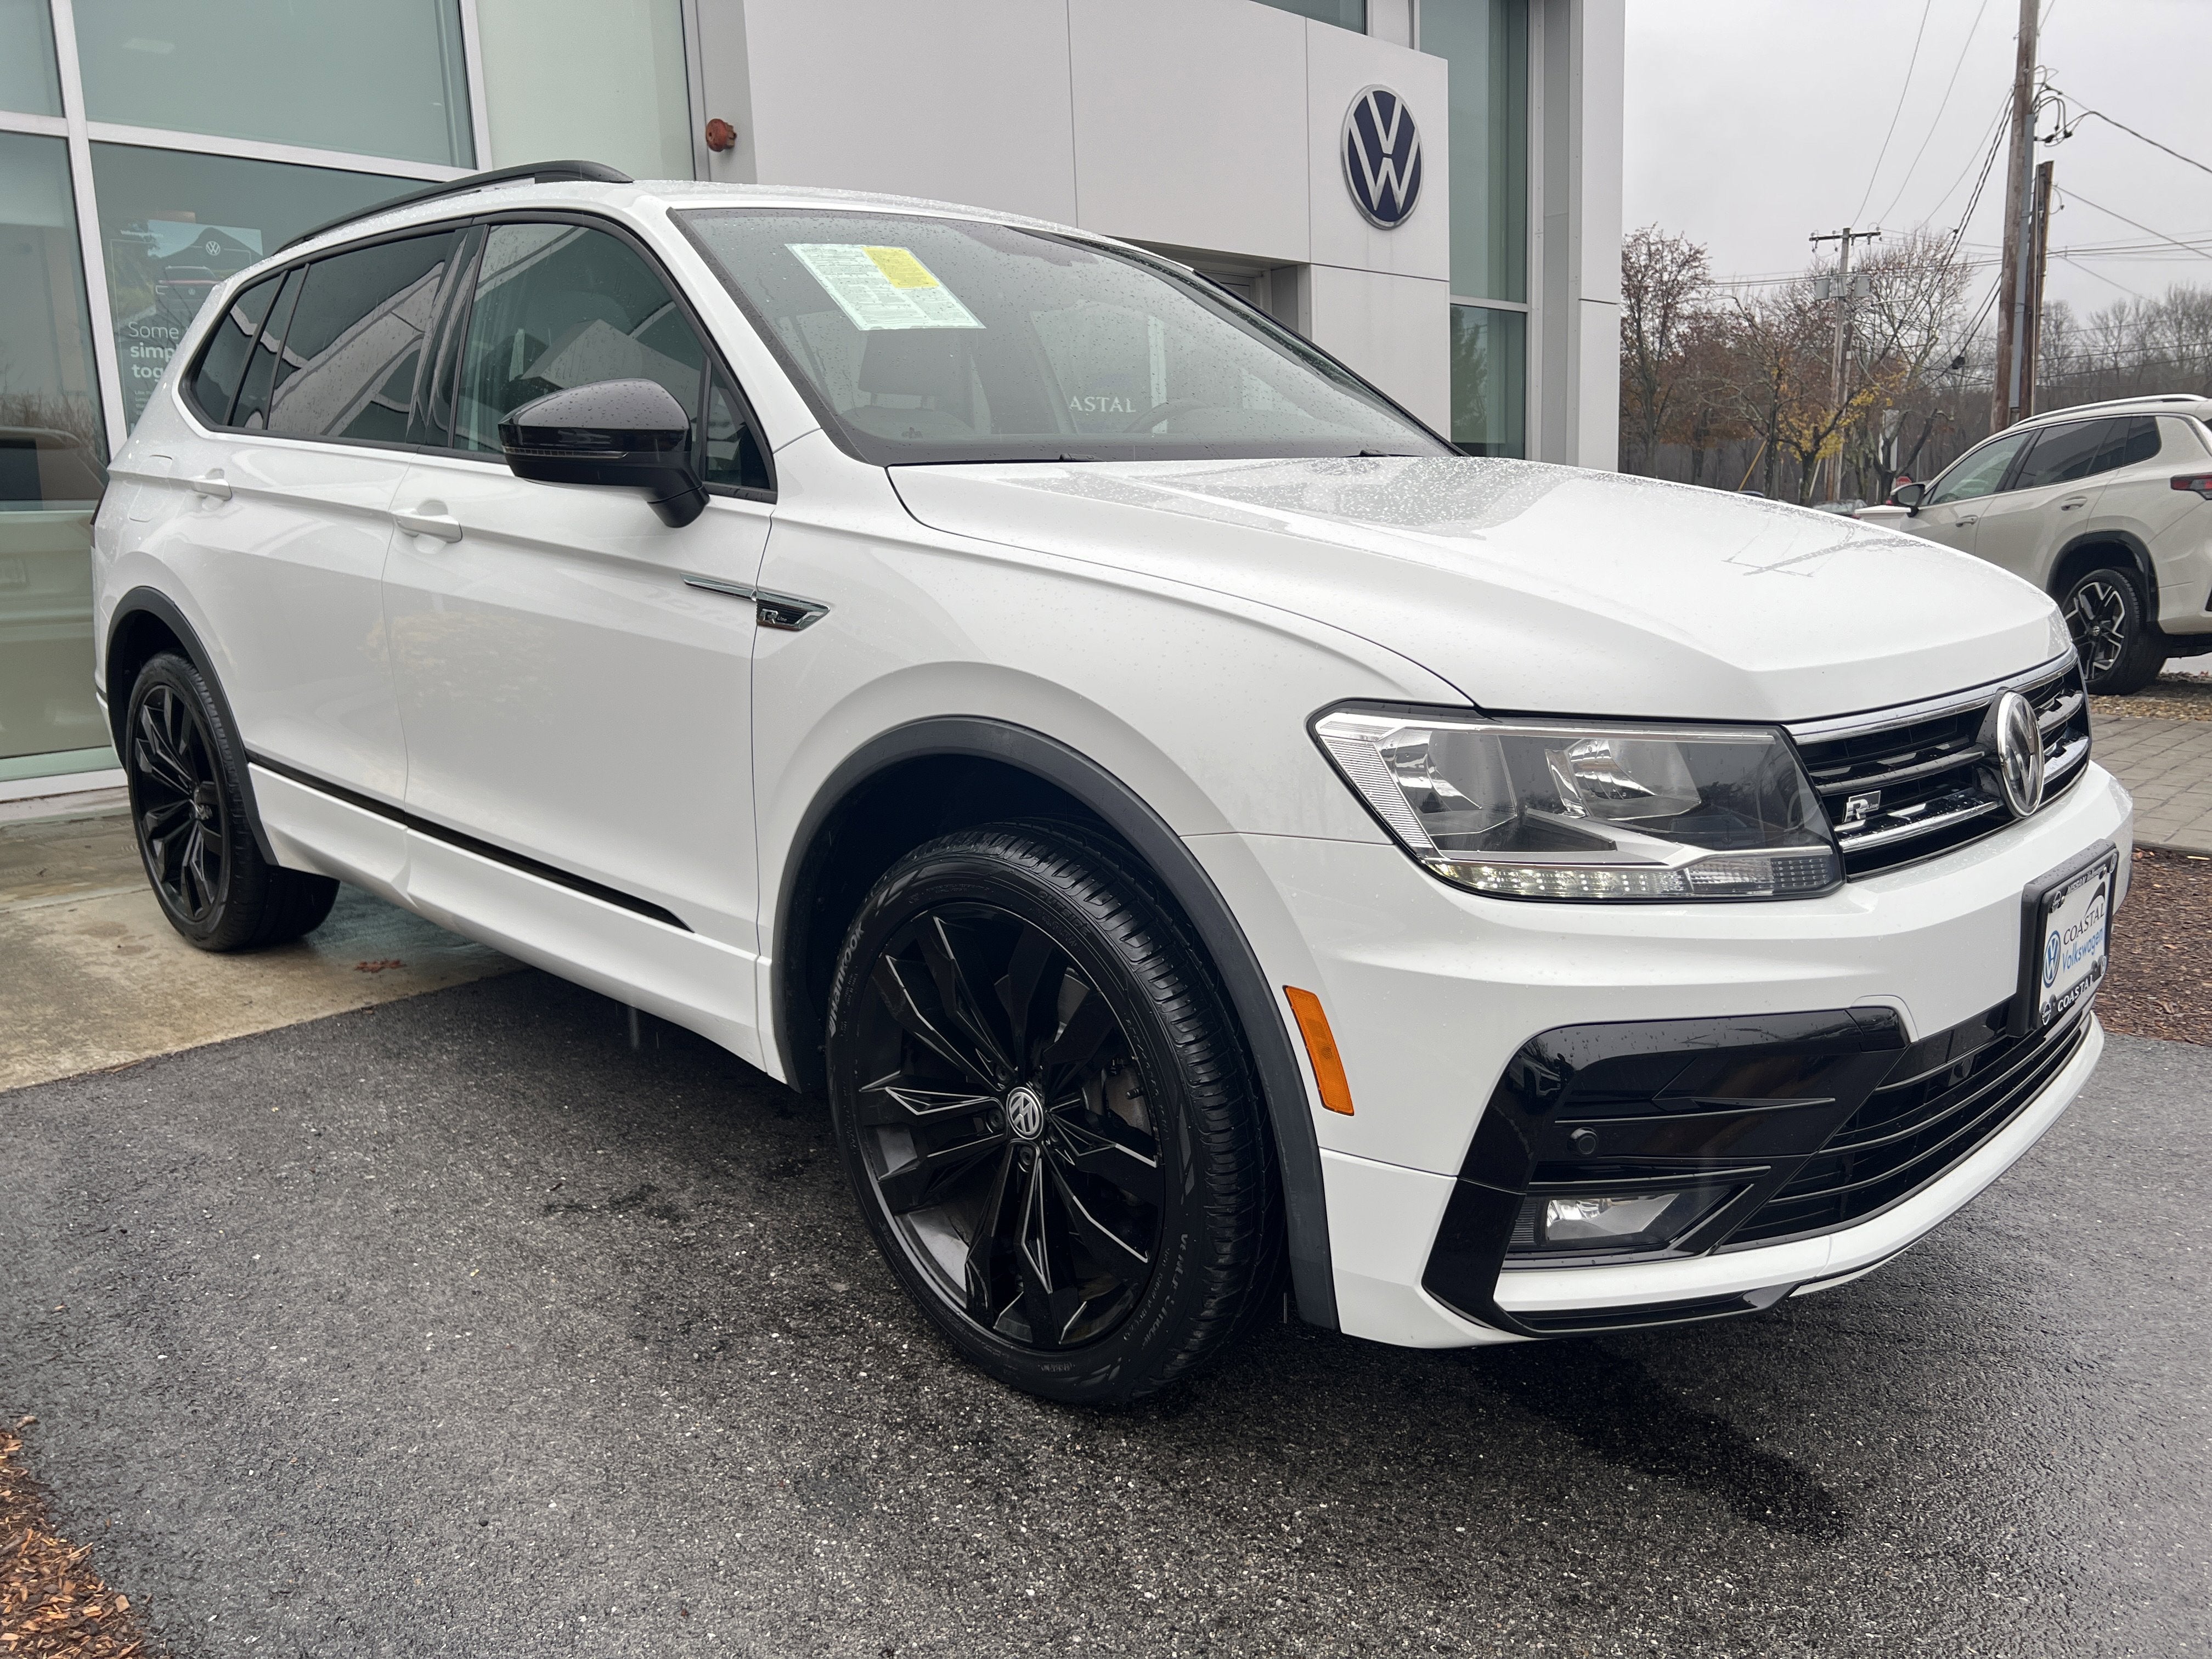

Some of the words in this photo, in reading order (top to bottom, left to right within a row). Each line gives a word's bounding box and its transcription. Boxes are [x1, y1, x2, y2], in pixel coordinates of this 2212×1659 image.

[128, 321, 179, 339] Some
[130, 342, 179, 362] simp
[1844, 799, 1867, 822] R
[2063, 902, 2104, 945] COASTAL
[2062, 928, 2103, 973] Volkswagen
[2057, 974, 2094, 1012] COASTAL
